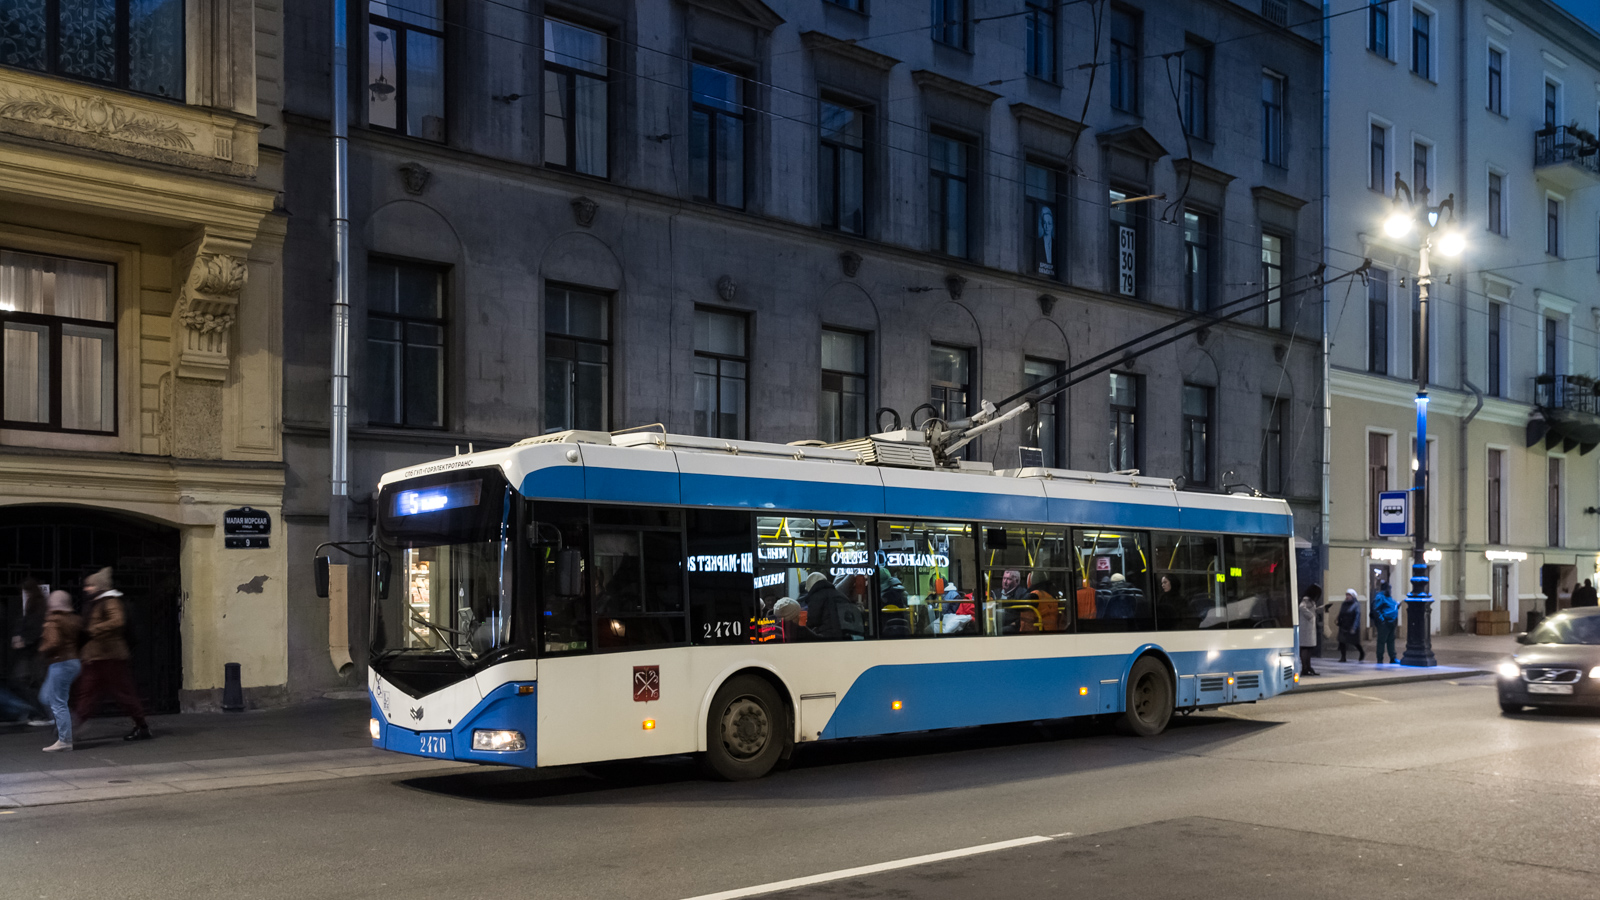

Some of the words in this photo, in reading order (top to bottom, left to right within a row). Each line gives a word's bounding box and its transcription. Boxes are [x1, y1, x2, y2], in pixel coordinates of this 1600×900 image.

[1120, 229, 1134, 251] 611
[1121, 252, 1133, 272] 30
[1121, 273, 1133, 293] 79
[410, 493, 418, 514] 5
[226, 517, 243, 525] МАЛАЯ
[244, 517, 267, 525] МОРСКАЯ
[246, 538, 250, 547] 9
[703, 620, 742, 639] 2470
[419, 735, 447, 754] 2470
